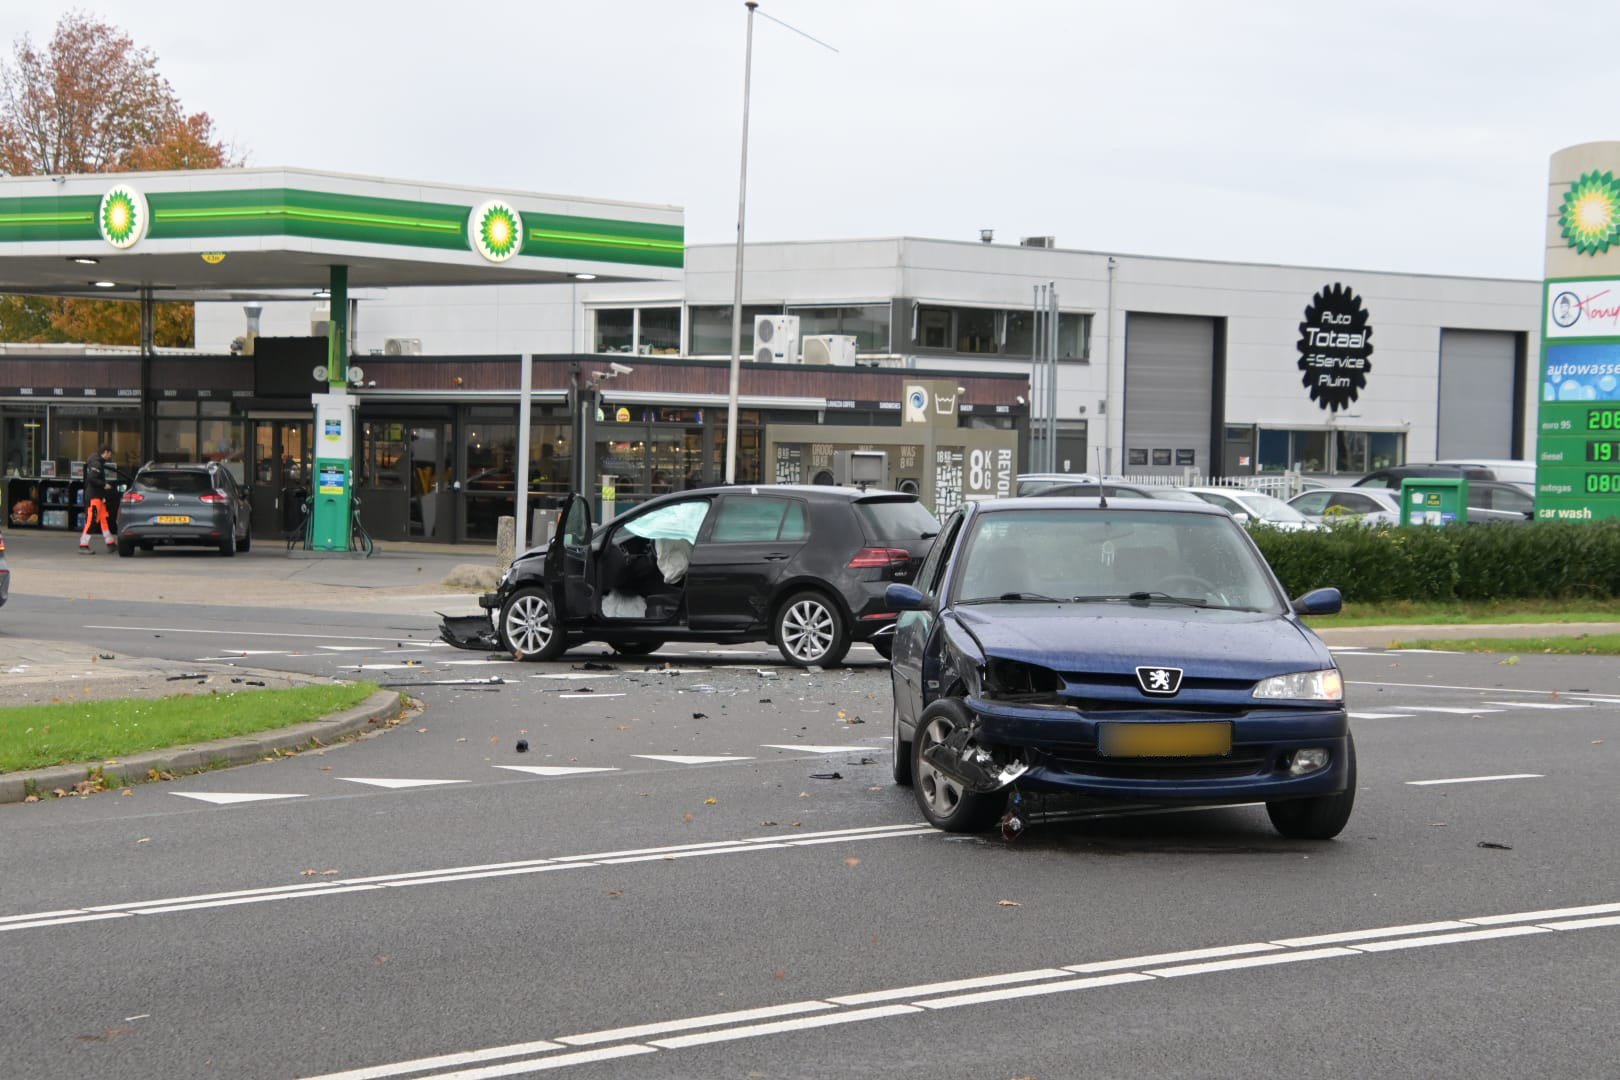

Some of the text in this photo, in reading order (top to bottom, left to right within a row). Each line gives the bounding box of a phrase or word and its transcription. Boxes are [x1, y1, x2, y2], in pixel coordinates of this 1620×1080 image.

[1321, 311, 1351, 325] Auto
[1306, 327, 1367, 348] Totaal
[1315, 354, 1365, 369] Service
[1560, 420, 1571, 429] 95
[901, 446, 916, 457] WAS
[1541, 452, 1563, 461] diesel
[970, 449, 984, 490] 8
[1539, 506, 1592, 519] car wash
